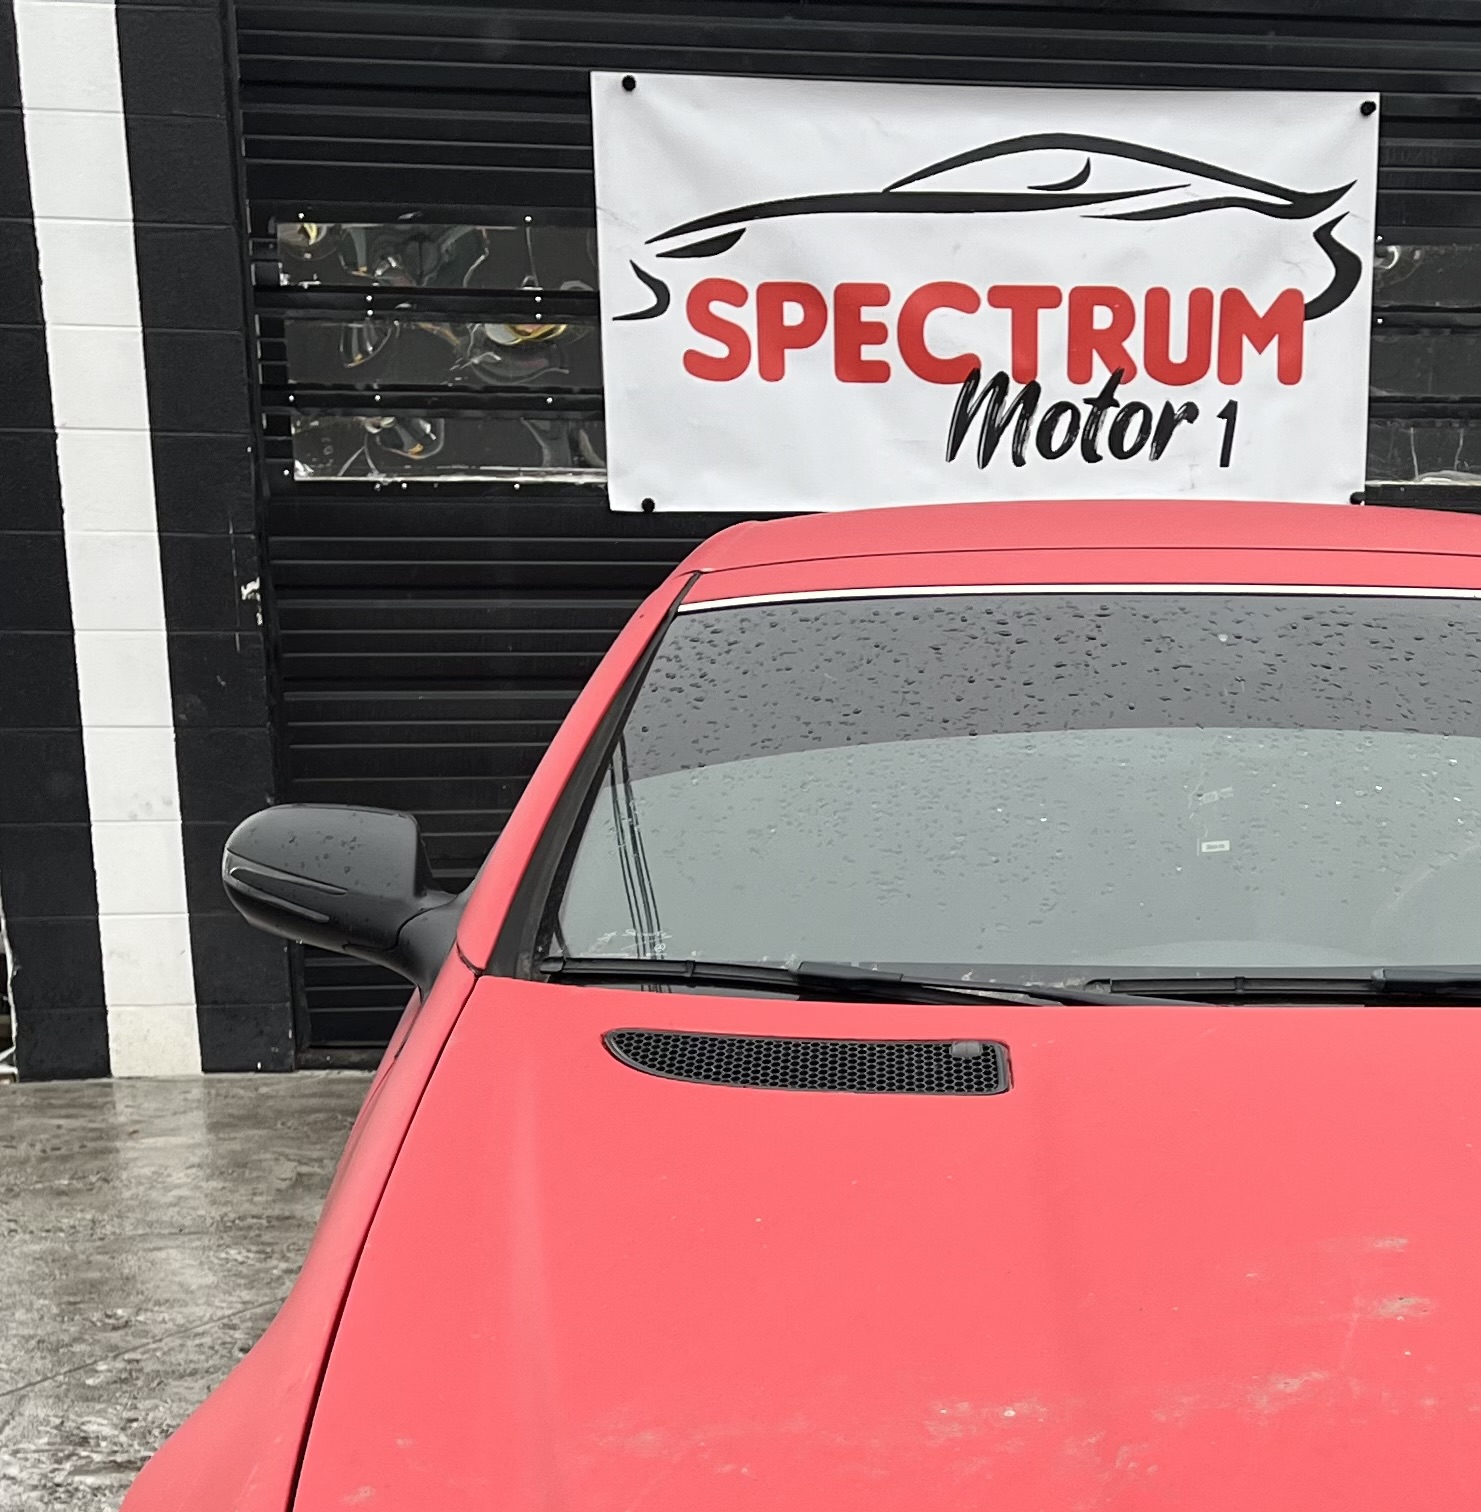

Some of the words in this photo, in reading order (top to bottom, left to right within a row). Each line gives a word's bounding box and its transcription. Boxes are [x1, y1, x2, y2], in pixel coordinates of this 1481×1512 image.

[682, 278, 1305, 386] SPECTRUM
[945, 367, 1199, 469] Motor
[1216, 399, 1238, 468] 1
